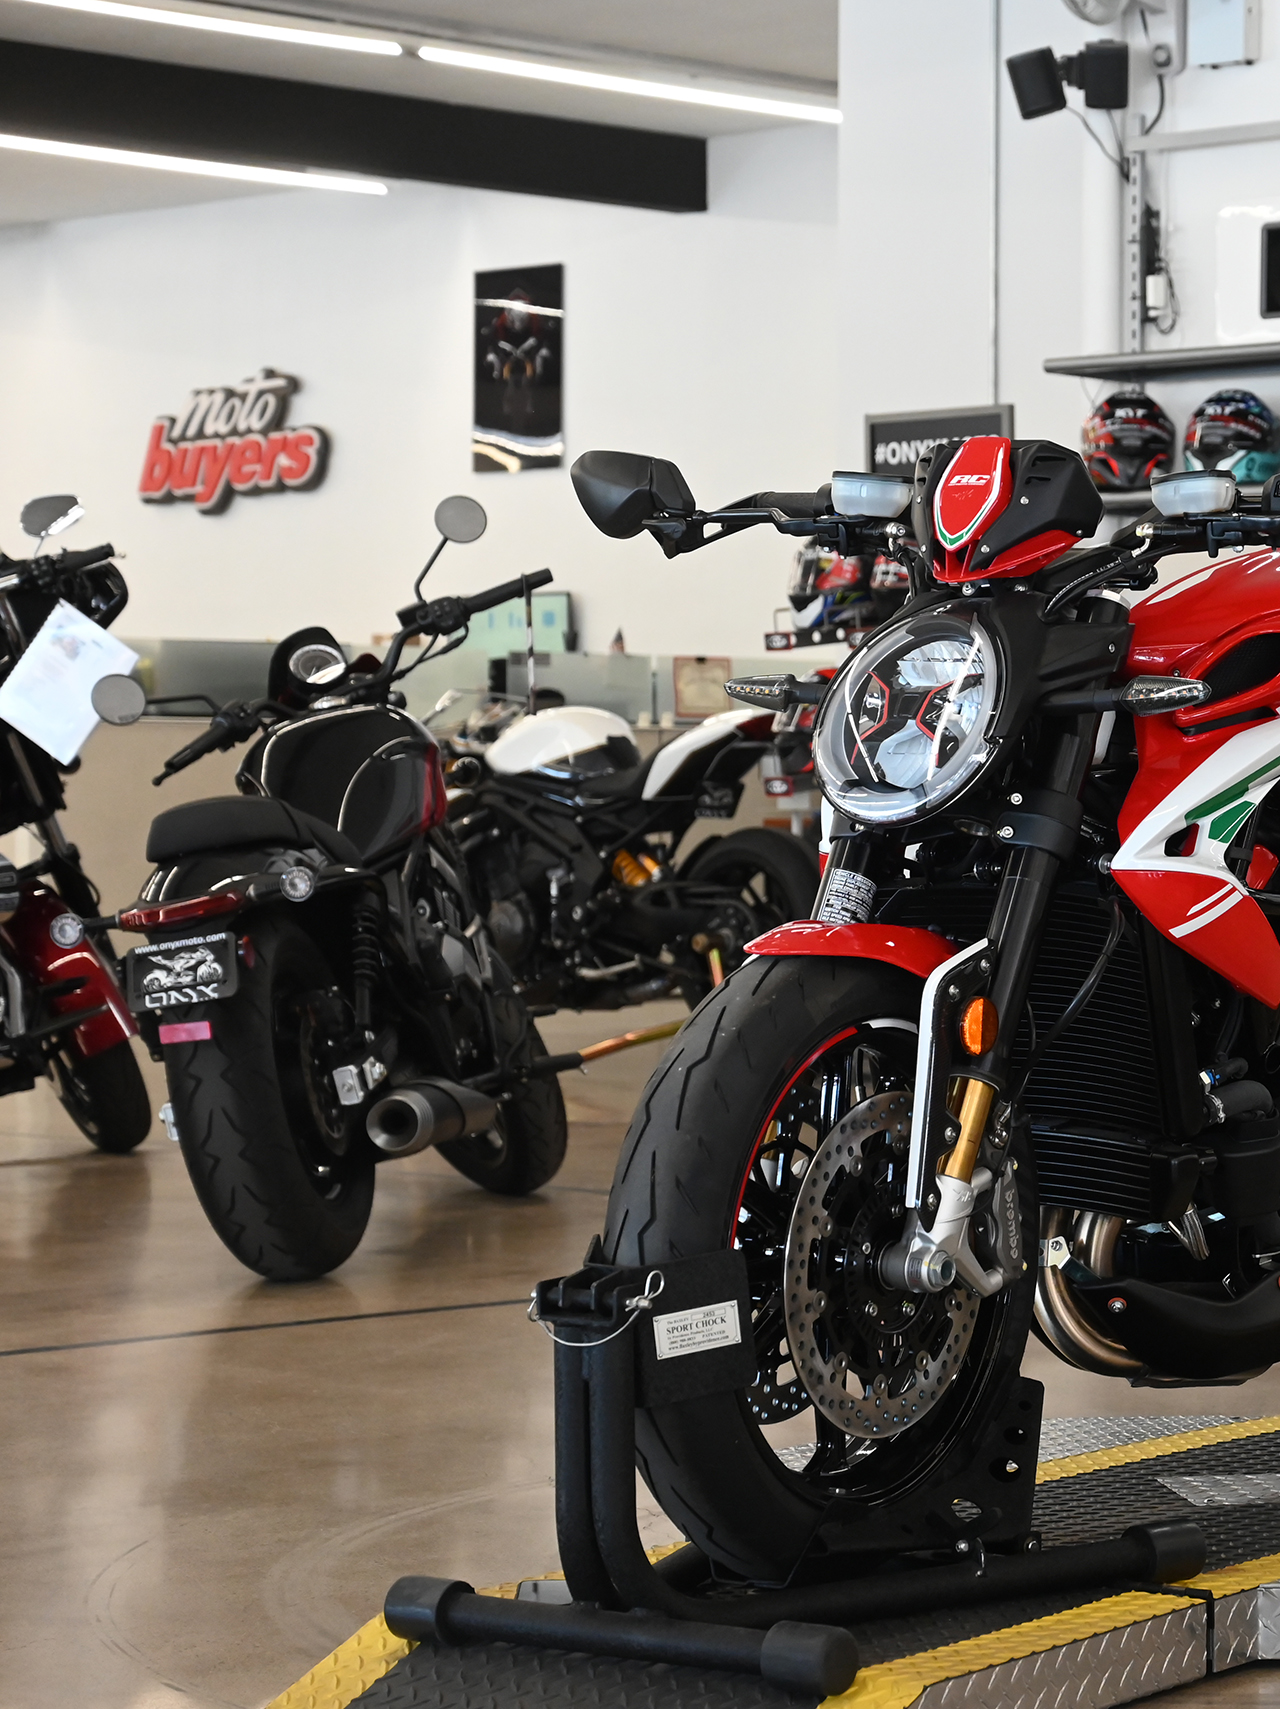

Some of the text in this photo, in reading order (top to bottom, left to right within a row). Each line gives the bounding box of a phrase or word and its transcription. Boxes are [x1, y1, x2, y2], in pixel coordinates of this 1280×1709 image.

[170, 376, 287, 439] Moto
[138, 421, 316, 507] buyers
[949, 474, 991, 485] RC
[134, 932, 226, 955] www.onyxmoto.com
[145, 983, 218, 1008] ONYX
[1004, 1188, 1018, 1260] brembo
[666, 1315, 727, 1335] SPORT CHOCK
